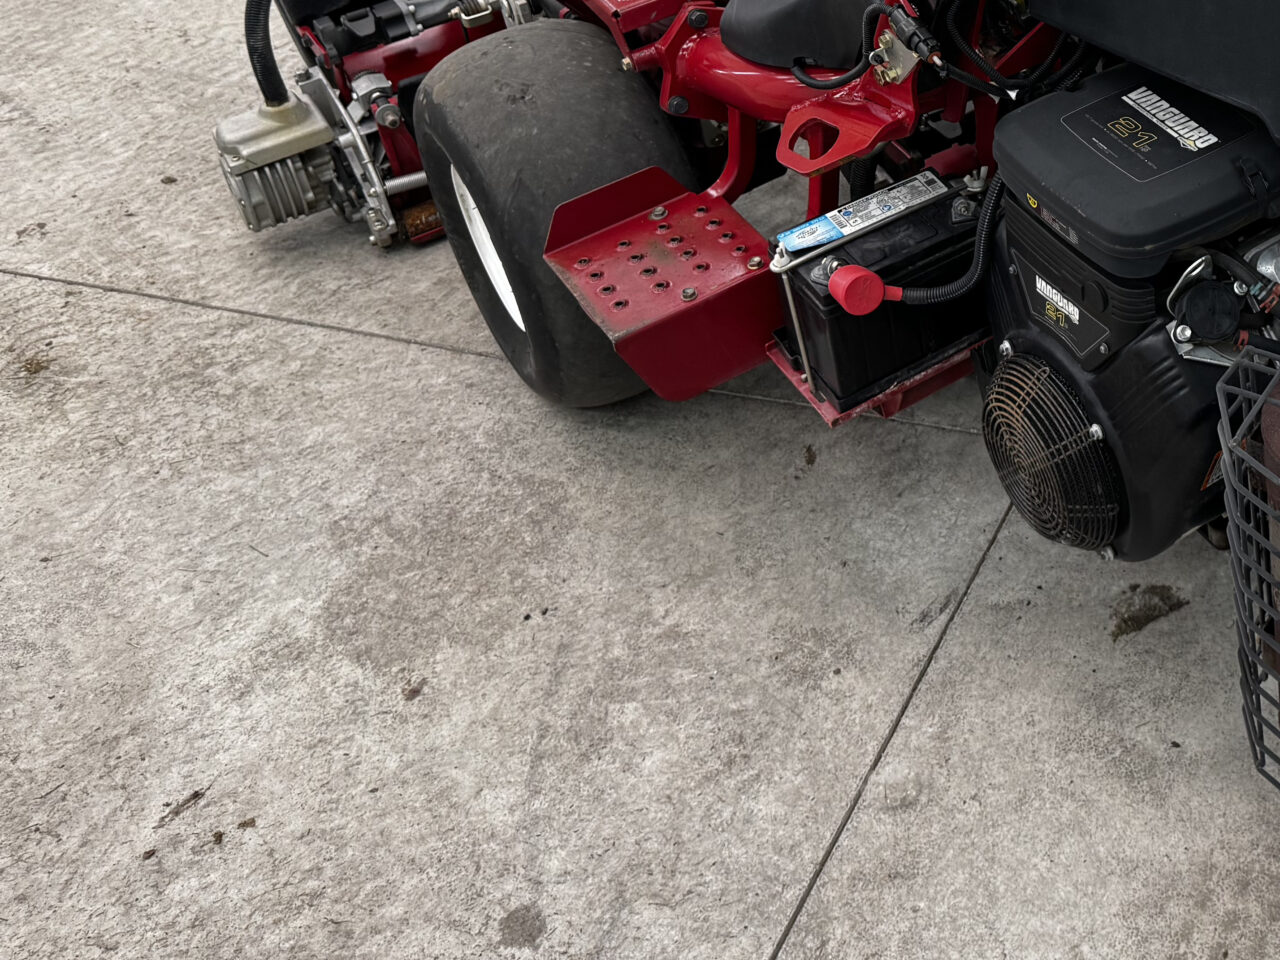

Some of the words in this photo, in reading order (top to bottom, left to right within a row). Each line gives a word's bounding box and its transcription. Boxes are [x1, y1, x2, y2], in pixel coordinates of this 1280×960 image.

[1107, 116, 1158, 148] 21
[1127, 86, 1219, 149] VANGUARD
[1035, 274, 1079, 321] VANGUARD
[1045, 301, 1065, 327] 21
